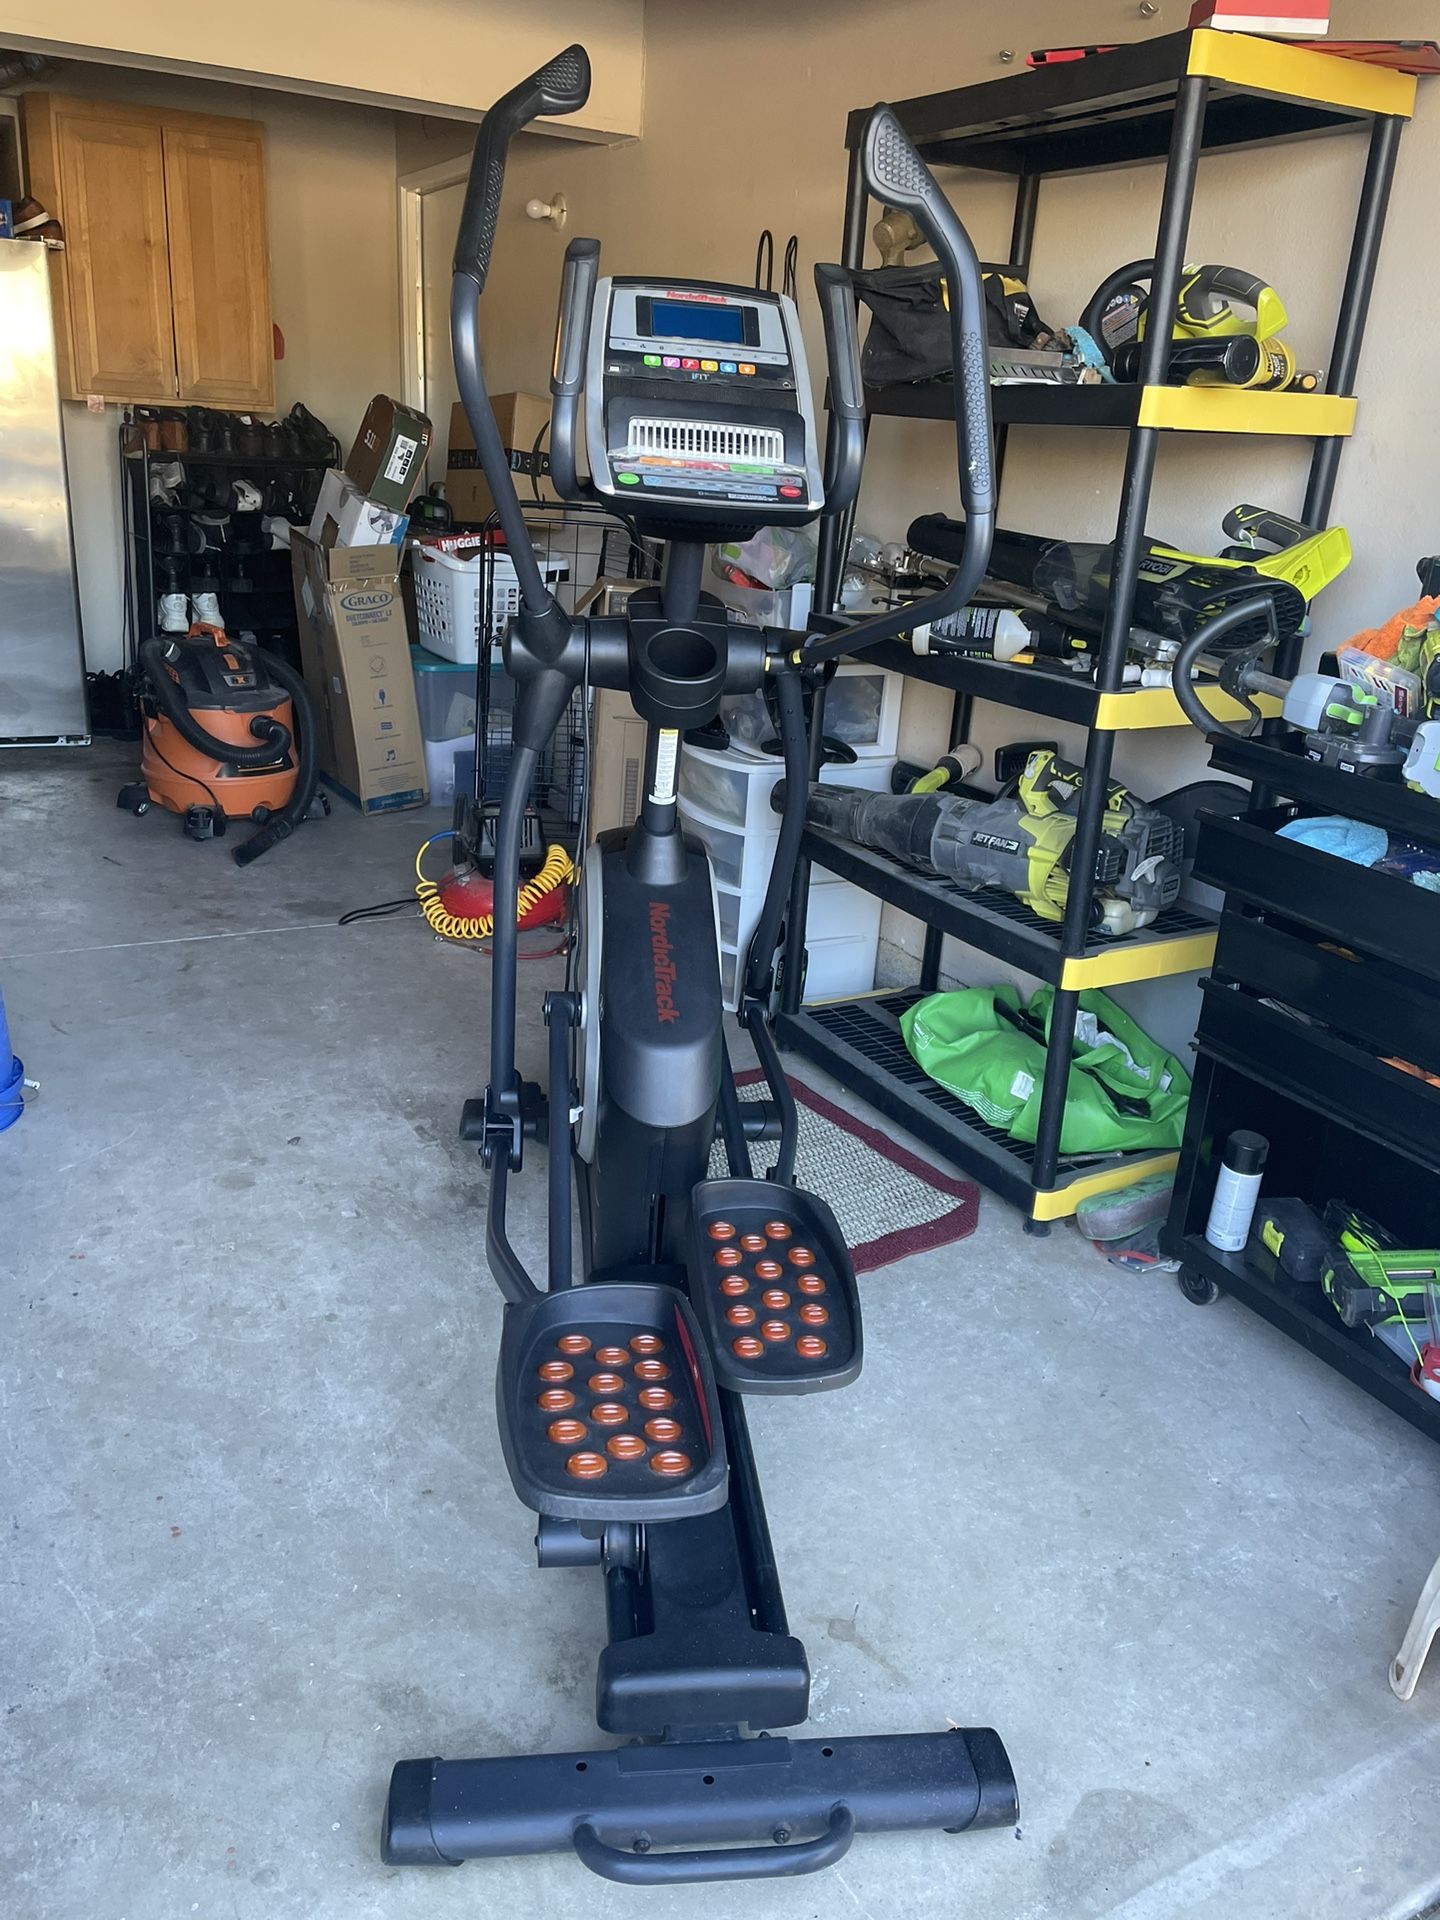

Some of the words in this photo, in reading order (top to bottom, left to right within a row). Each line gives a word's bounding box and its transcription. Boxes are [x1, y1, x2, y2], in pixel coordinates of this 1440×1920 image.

[441, 536, 487, 551] HUGGIE
[1139, 560, 1173, 574] RYOBI
[348, 594, 388, 606] GRACO
[649, 902, 680, 1024] NordicTrack
